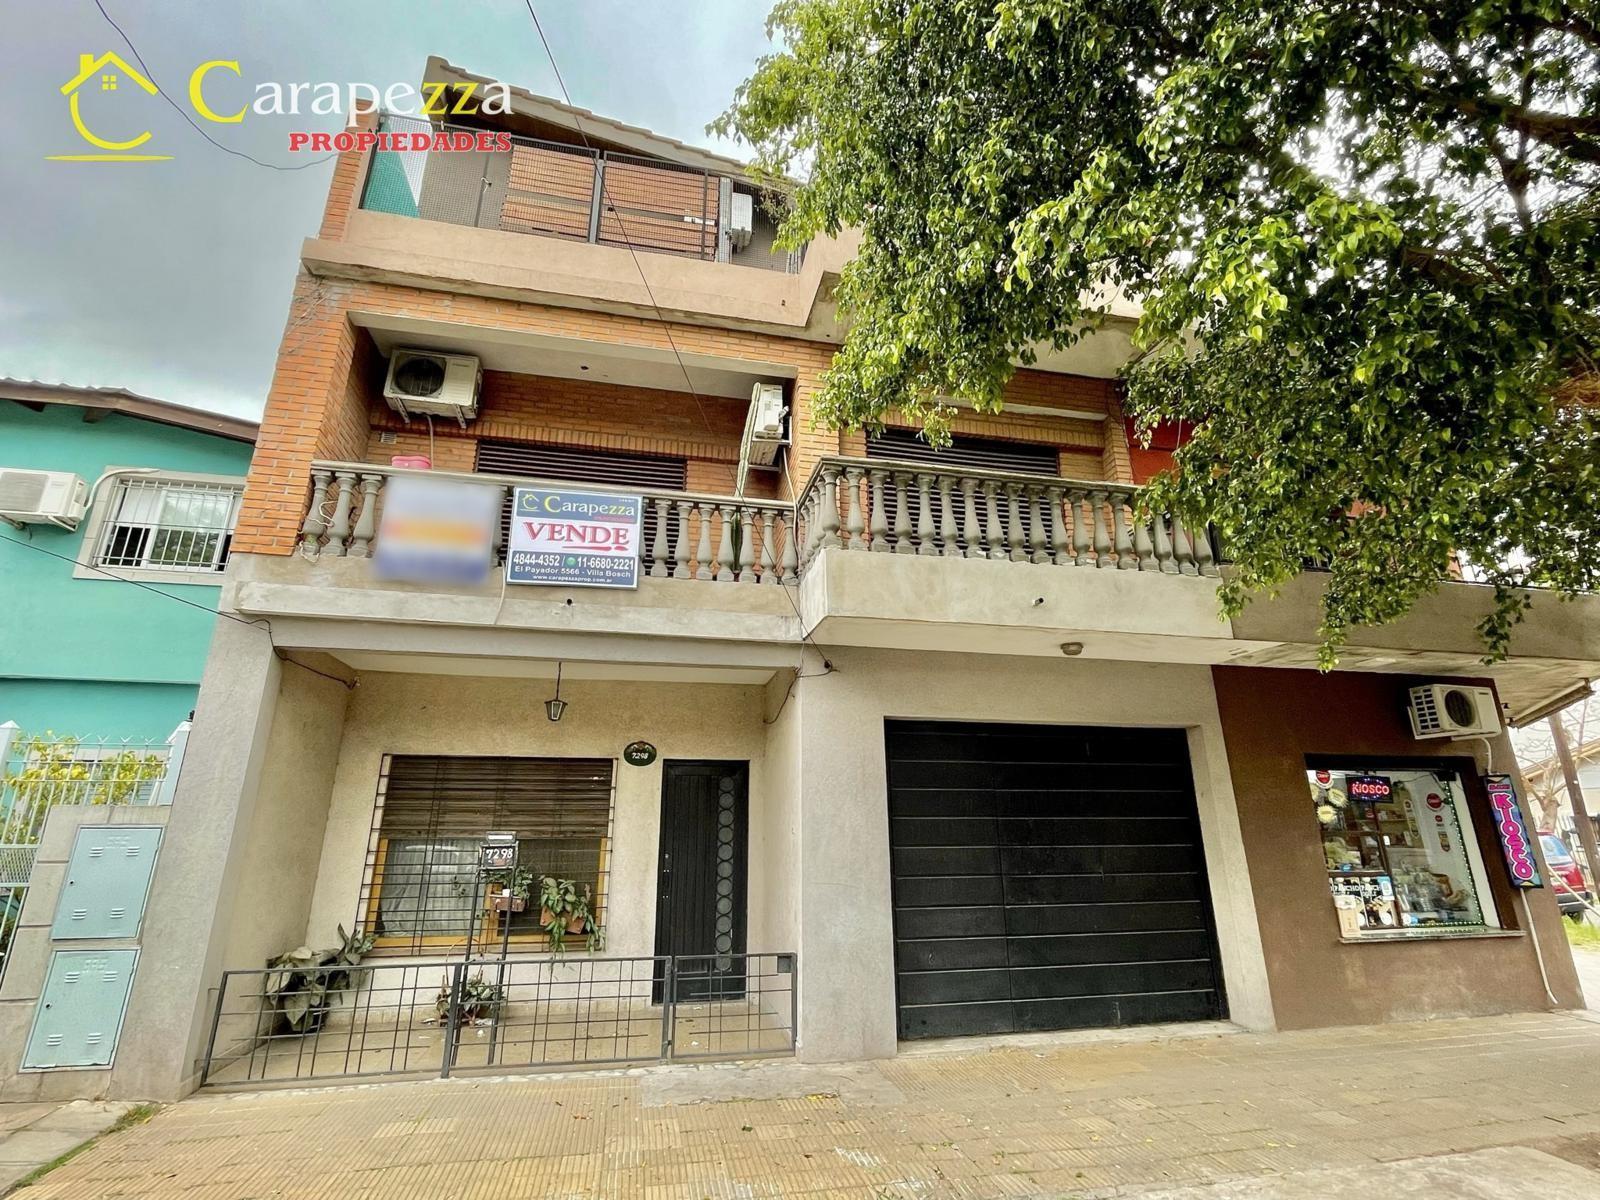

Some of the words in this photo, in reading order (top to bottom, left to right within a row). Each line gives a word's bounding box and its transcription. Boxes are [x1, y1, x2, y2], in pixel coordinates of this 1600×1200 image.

[544, 495, 635, 516] Carapezza
[523, 521, 630, 545] VENDE
[513, 552, 560, 566] 4844-4352
[577, 557, 634, 570] 11-6680-2221
[525, 566, 558, 575] Payador
[605, 570, 631, 578] Bosch
[631, 752, 649, 760] 7298
[1351, 783, 1390, 795] KIOSCO
[1492, 792, 1535, 880] KIOSCO
[486, 848, 513, 859] 7298
